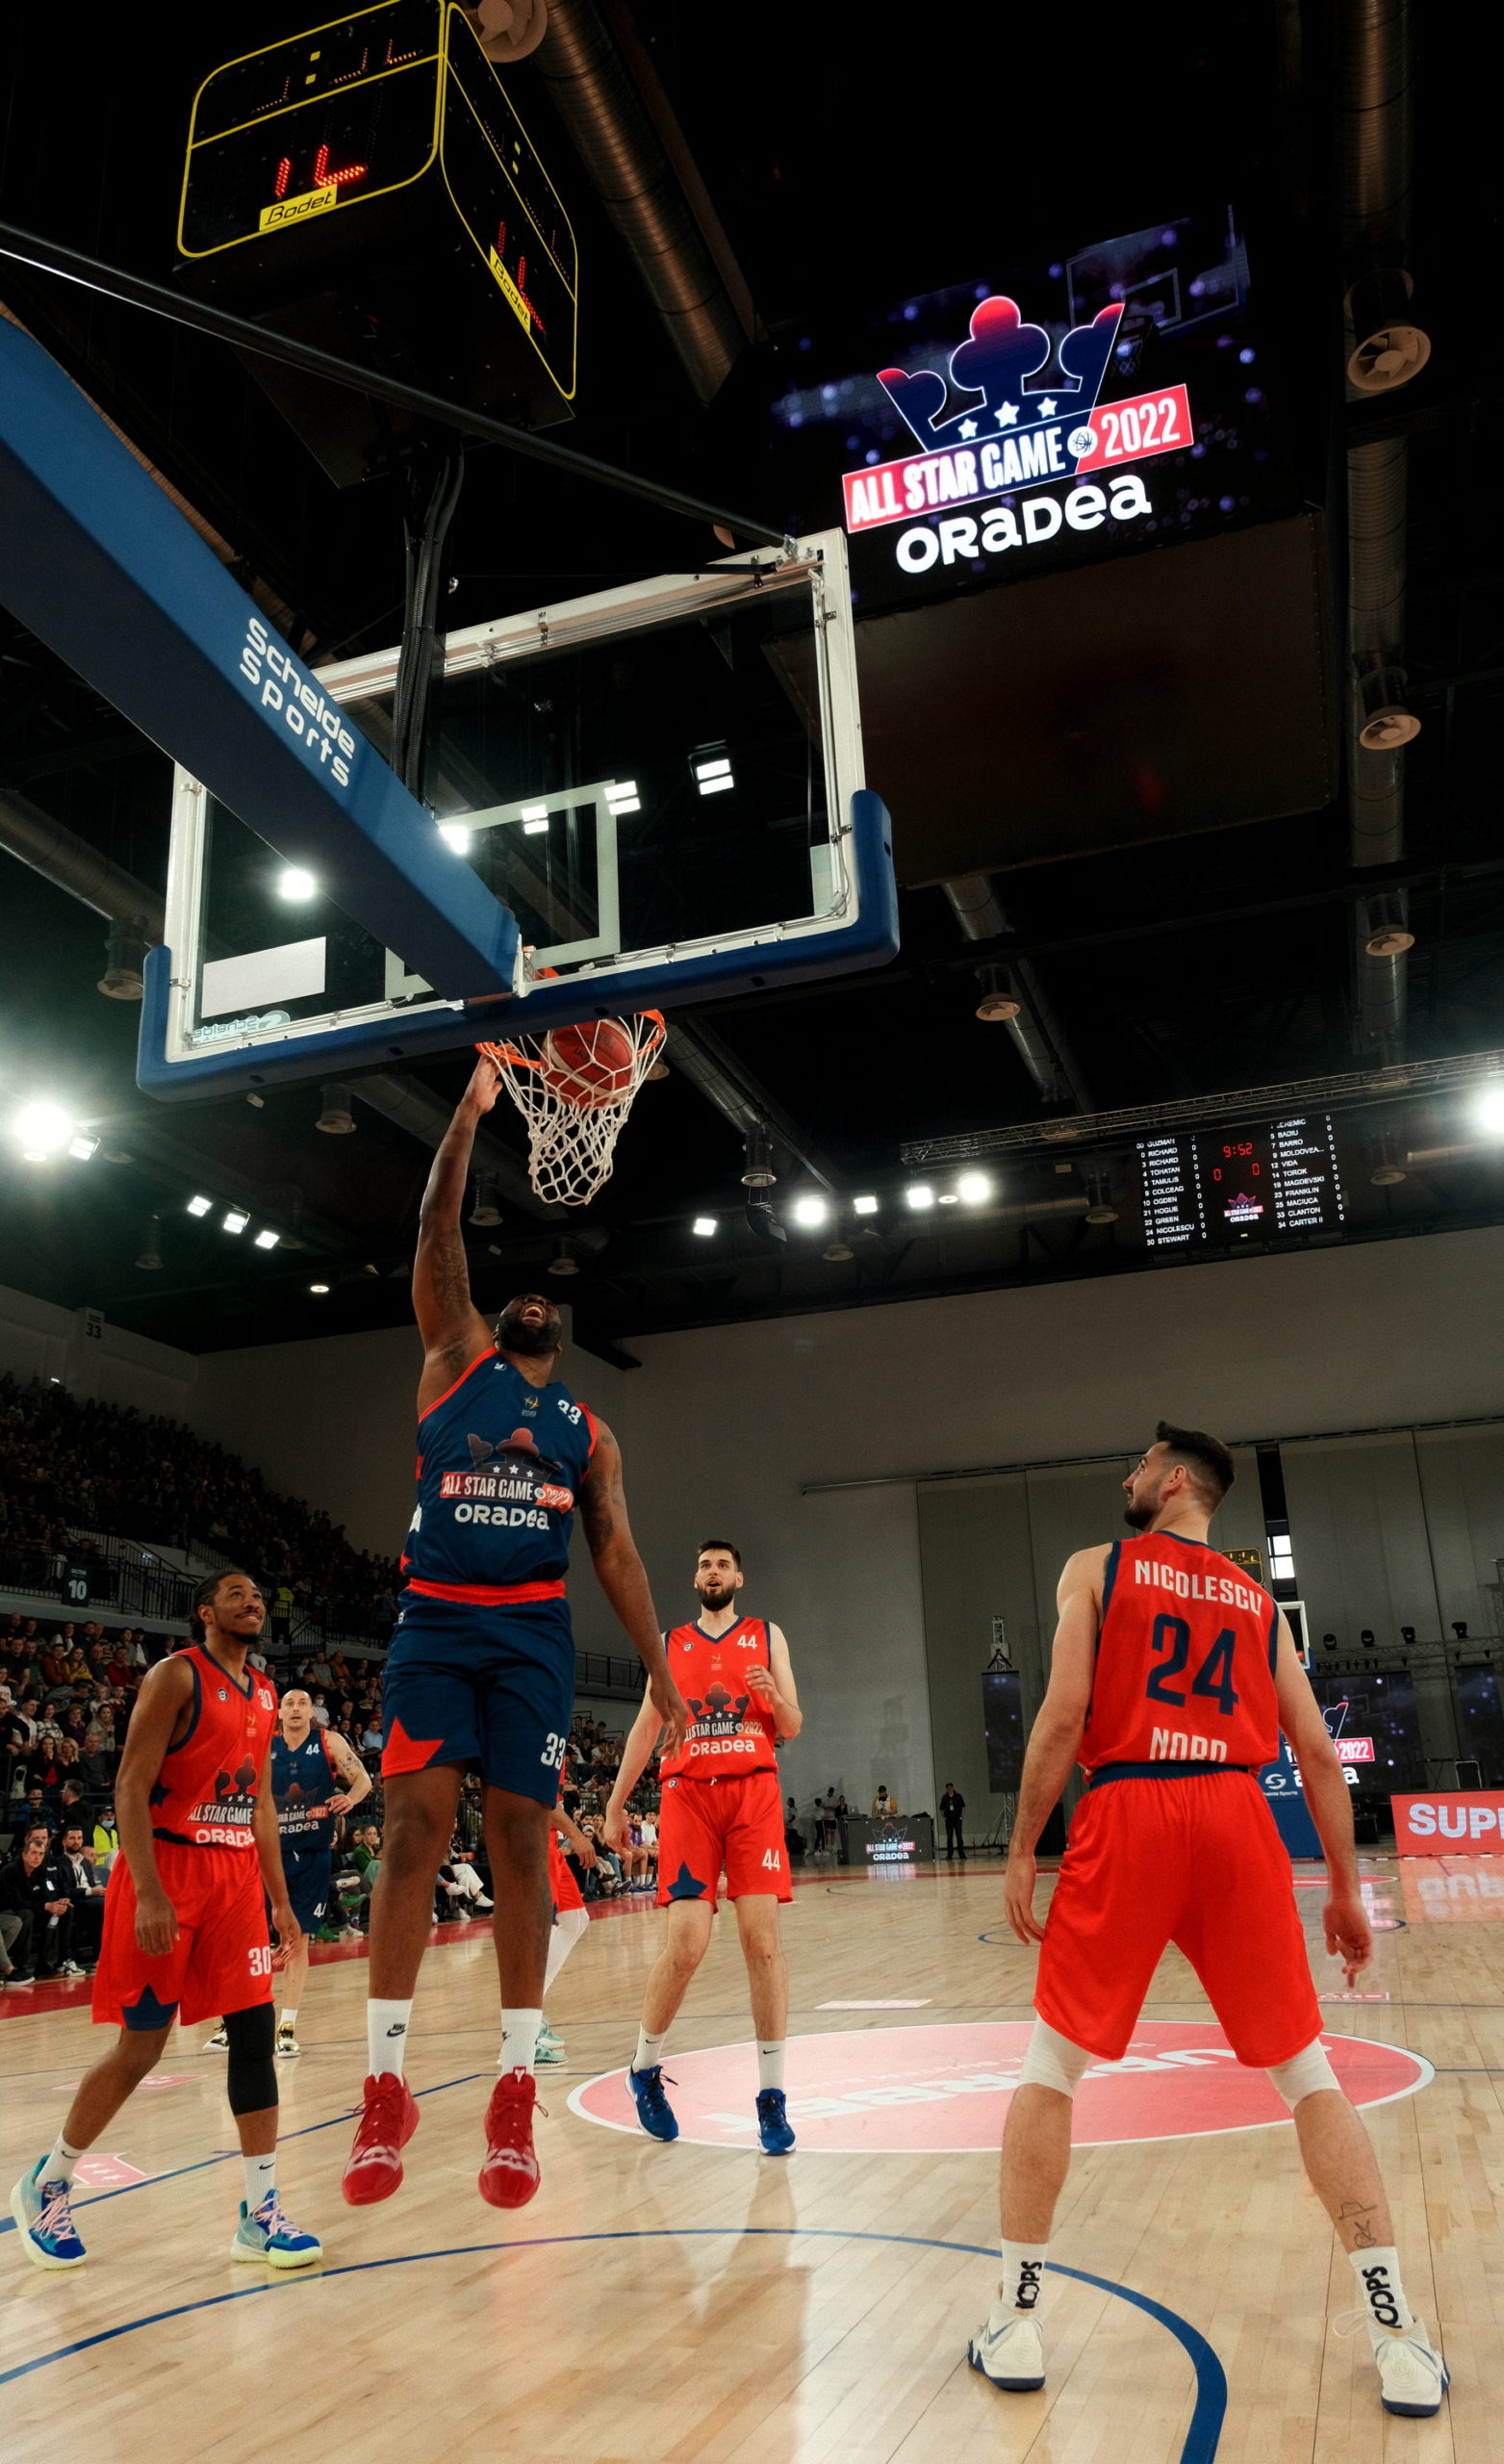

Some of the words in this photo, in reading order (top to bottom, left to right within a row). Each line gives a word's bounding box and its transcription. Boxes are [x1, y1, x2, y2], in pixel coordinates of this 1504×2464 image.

[265, 191, 334, 226] Bodet
[492, 256, 531, 325] Bodet
[851, 472, 904, 525] ALL
[904, 450, 980, 511] STAR
[981, 427, 1066, 491] GAME
[1101, 398, 1181, 458] 2022
[246, 617, 355, 759] Schelde
[240, 647, 350, 787] Sports
[1278, 1130, 1299, 1139] BADIU
[1148, 1147, 1178, 1157] RICHARD
[1223, 1142, 1253, 1159] 9:52
[1279, 1139, 1303, 1148] BARRO
[1149, 1157, 1179, 1167] RICHARD
[1282, 1159, 1299, 1168] VIDA
[1213, 1168, 1222, 1181] 0
[1252, 1163, 1261, 1176] 0
[1283, 1168, 1308, 1177] TOROK
[1153, 1196, 1178, 1205] OGDEN
[1286, 1187, 1320, 1197] FRANKLIN
[1155, 1216, 1180, 1224] GREEN
[1287, 1207, 1321, 1218] CLANTON
[1157, 1223, 1195, 1235] NICOLESCU
[1289, 1217, 1318, 1227] CARTER
[1158, 1234, 1189, 1245] STEWART
[443, 1476, 462, 1495] ALL
[464, 1476, 497, 1497] STAR
[498, 1478, 534, 1501] GAME
[69, 1579, 88, 1600] 10
[1134, 1559, 1262, 1617] NICOLESCU
[737, 1634, 758, 1650] 44
[1145, 1612, 1239, 1716] 24
[257, 1688, 274, 1710] 30
[692, 1723, 710, 1738] STAR
[712, 1721, 735, 1736] GAME
[744, 1721, 764, 1735] 2022
[305, 1743, 320, 1756] 44
[541, 1732, 566, 1770] 33
[1338, 1740, 1370, 1760] 2022
[187, 1804, 203, 1822] ALL
[202, 1804, 227, 1823] STAR
[227, 1806, 253, 1825] GAME
[277, 1812, 289, 1824] TAR
[289, 1810, 306, 1822] GAME
[1408, 1803, 1504, 1839] SUP
[762, 1848, 780, 1872] 44
[248, 1947, 271, 1976] 30
